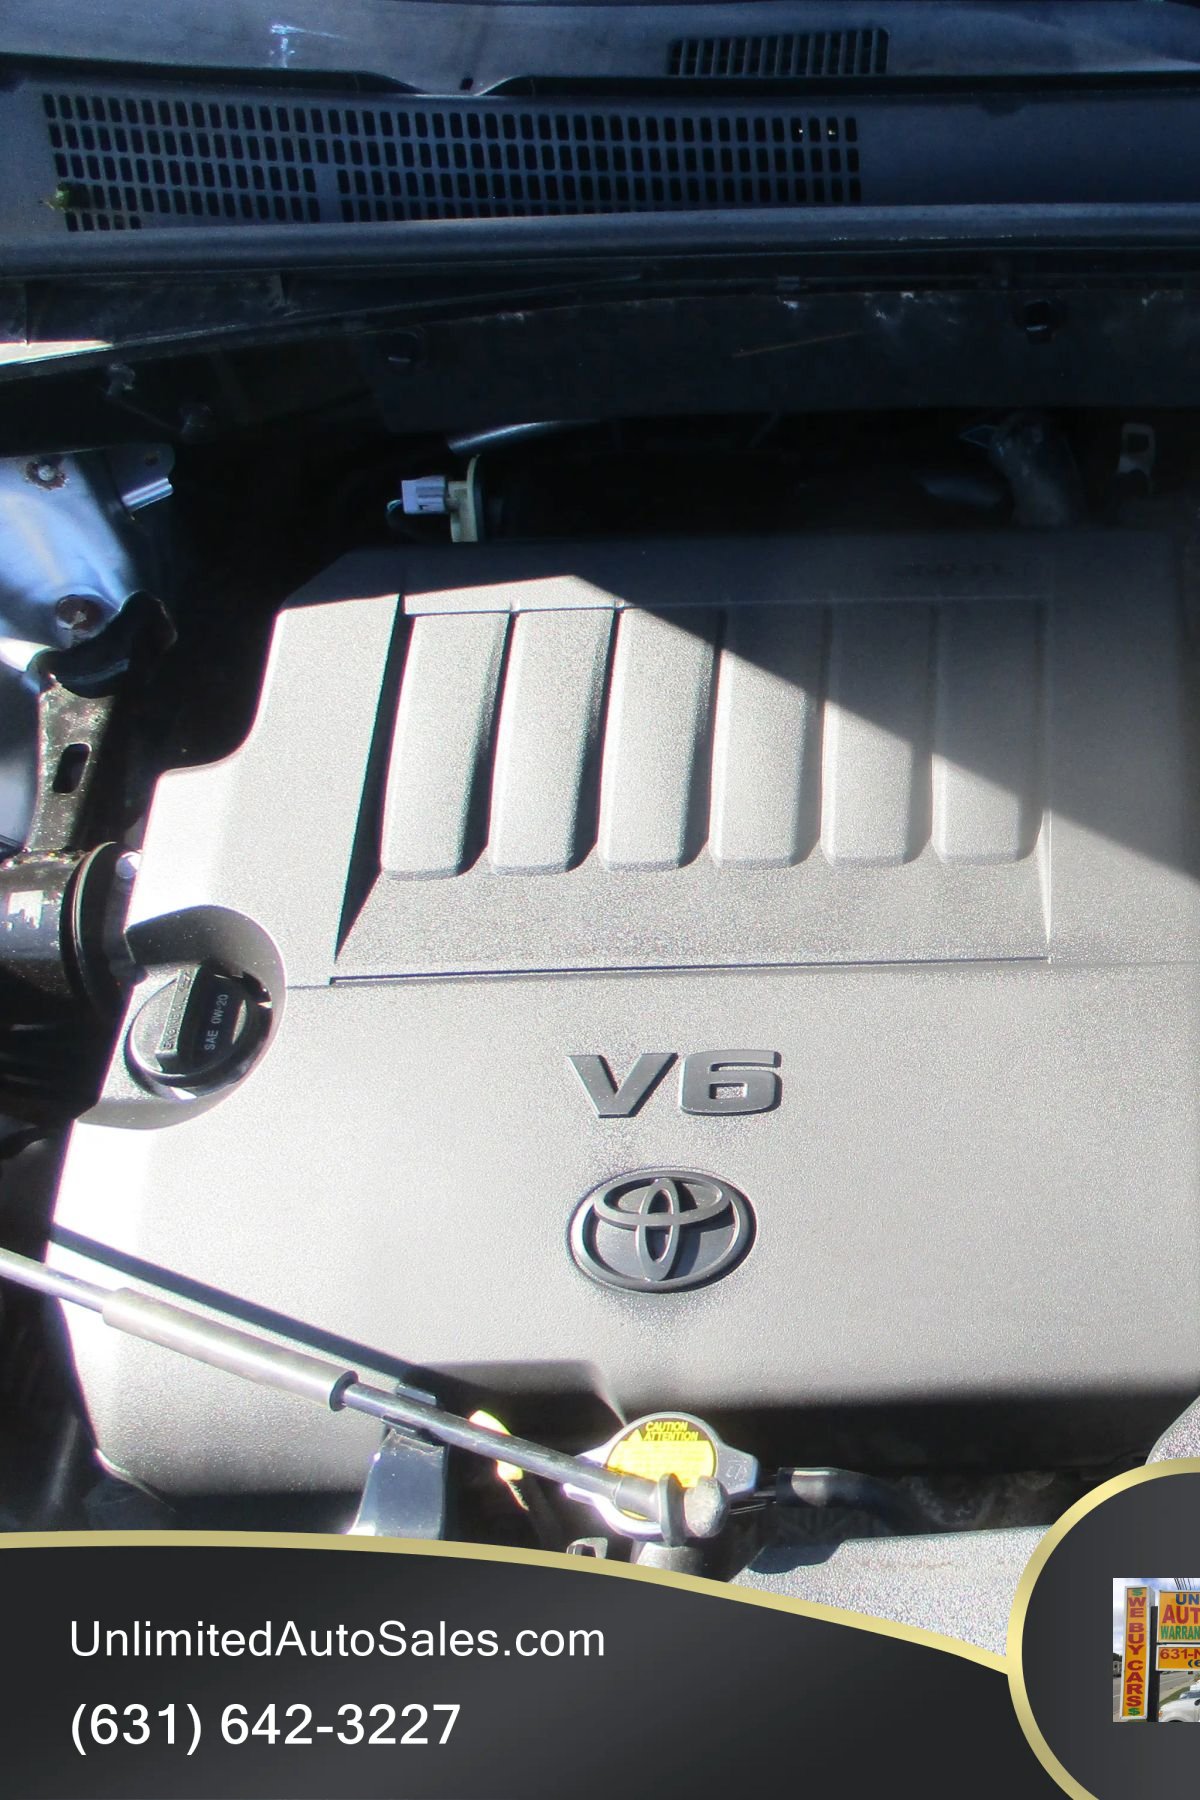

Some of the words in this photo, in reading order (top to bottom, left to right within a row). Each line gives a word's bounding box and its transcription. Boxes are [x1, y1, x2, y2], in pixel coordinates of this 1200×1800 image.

[204, 1030, 219, 1051] SAE
[213, 994, 229, 1024] 0W-20
[566, 1050, 783, 1118] V6
[643, 1432, 699, 1442] ATTENTION
[645, 1421, 689, 1432] CAUTION
